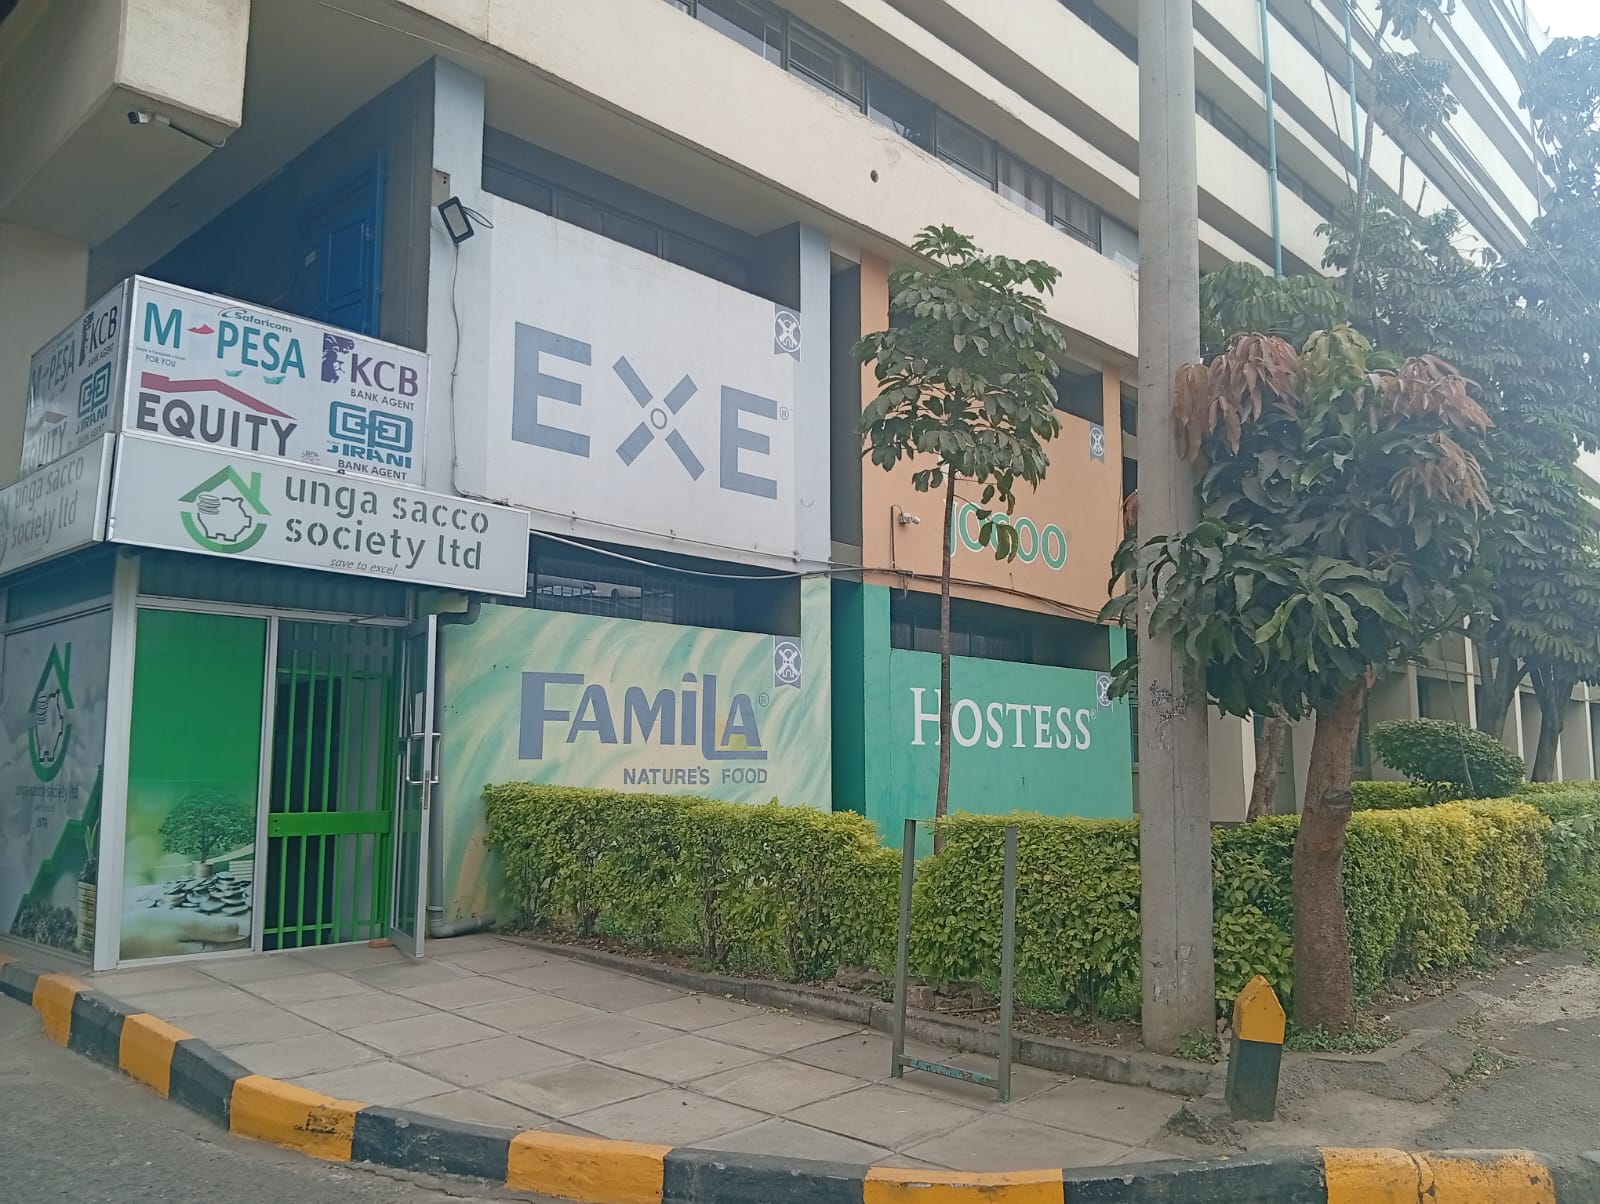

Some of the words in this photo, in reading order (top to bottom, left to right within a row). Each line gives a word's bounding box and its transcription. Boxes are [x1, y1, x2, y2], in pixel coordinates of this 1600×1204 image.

[89, 306, 117, 353] KCB
[234, 309, 292, 334] Safaricom
[145, 354, 160, 364] FOR
[160, 358, 176, 367] YOU
[350, 353, 418, 397] KCB
[350, 388, 379, 403] BANK
[381, 396, 415, 411] AGENT
[137, 391, 298, 456] EQUITY
[327, 443, 412, 469] JIRANI
[338, 460, 368, 473] BANK
[371, 466, 407, 480] AGENT
[15, 477, 43, 511] unga
[46, 456, 84, 495] sacco
[285, 476, 378, 519] unga
[392, 496, 489, 534] sacco
[11, 506, 56, 549] society
[58, 490, 78, 529] ltd
[285, 517, 426, 569] society
[437, 534, 482, 570] ltd
[329, 558, 354, 570] save
[356, 560, 367, 571] to
[370, 563, 398, 575] excel
[910, 687, 1091, 750] HOSTESS
[722, 767, 768, 784] FOOD
